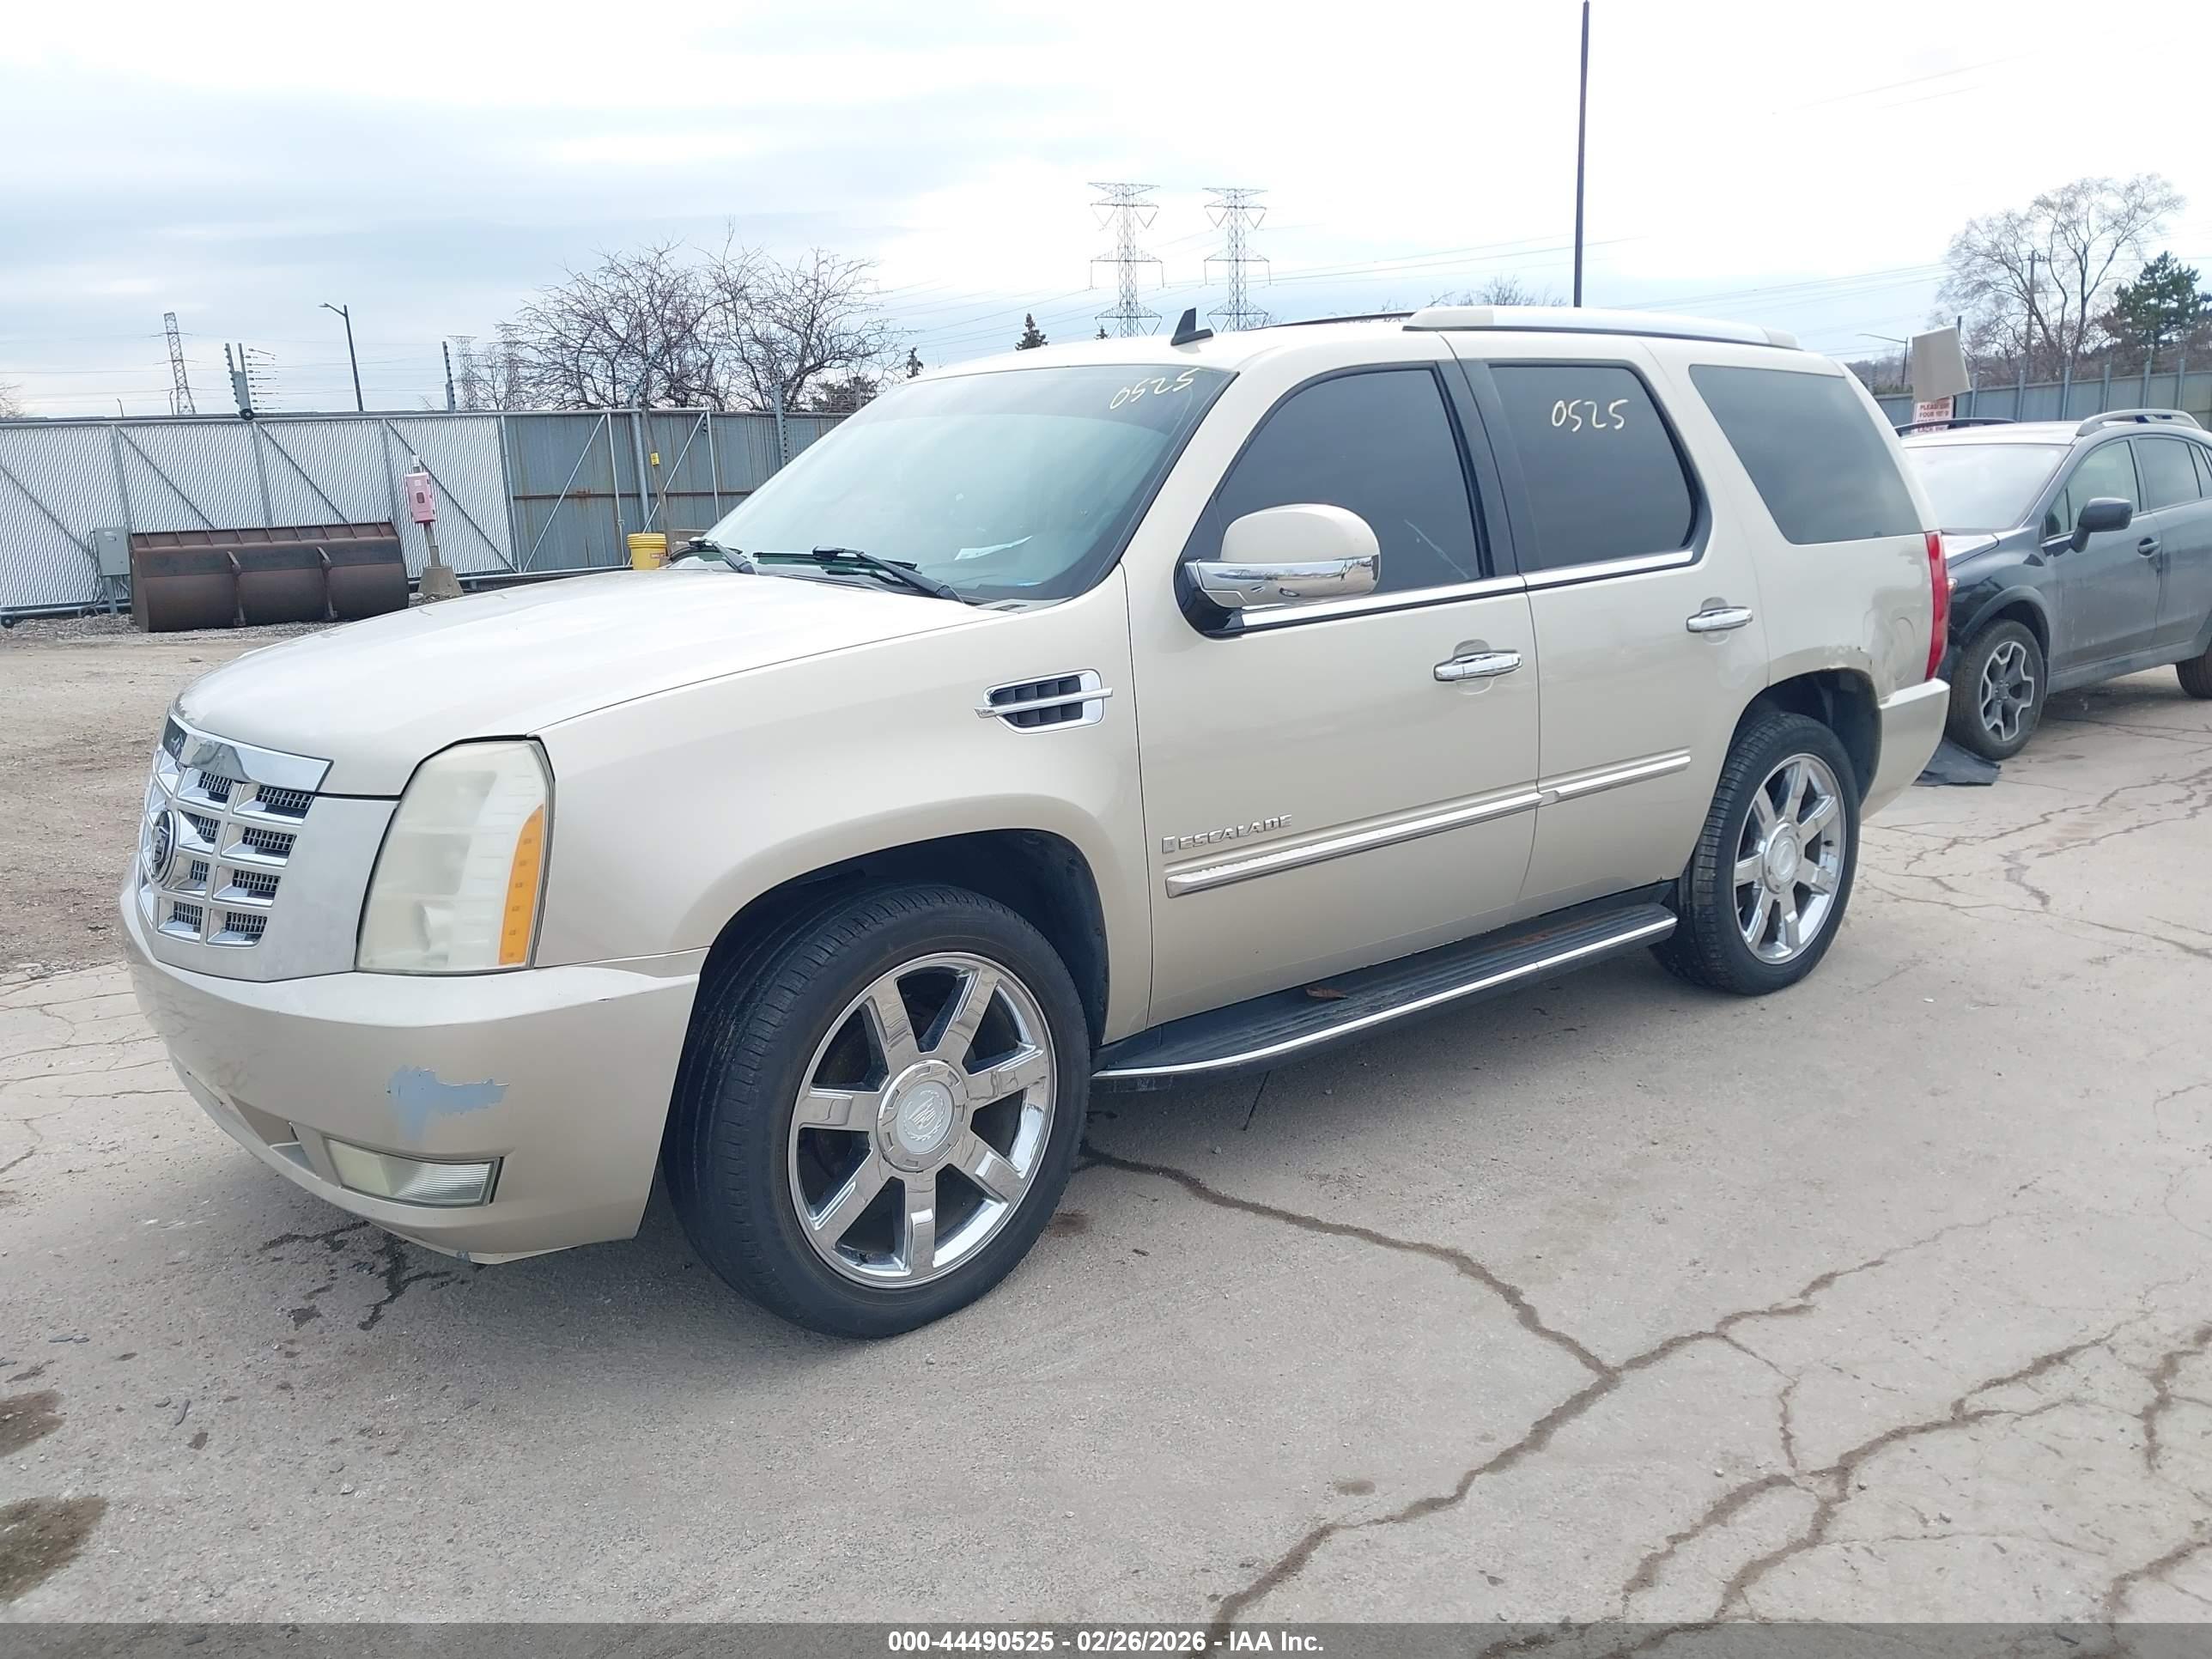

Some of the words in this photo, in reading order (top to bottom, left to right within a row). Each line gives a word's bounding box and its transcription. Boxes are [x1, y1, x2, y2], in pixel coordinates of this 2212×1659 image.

[1109, 368, 1200, 410] 0525
[1552, 399, 1628, 432] 0525
[1179, 814, 1291, 850] ESCALADE
